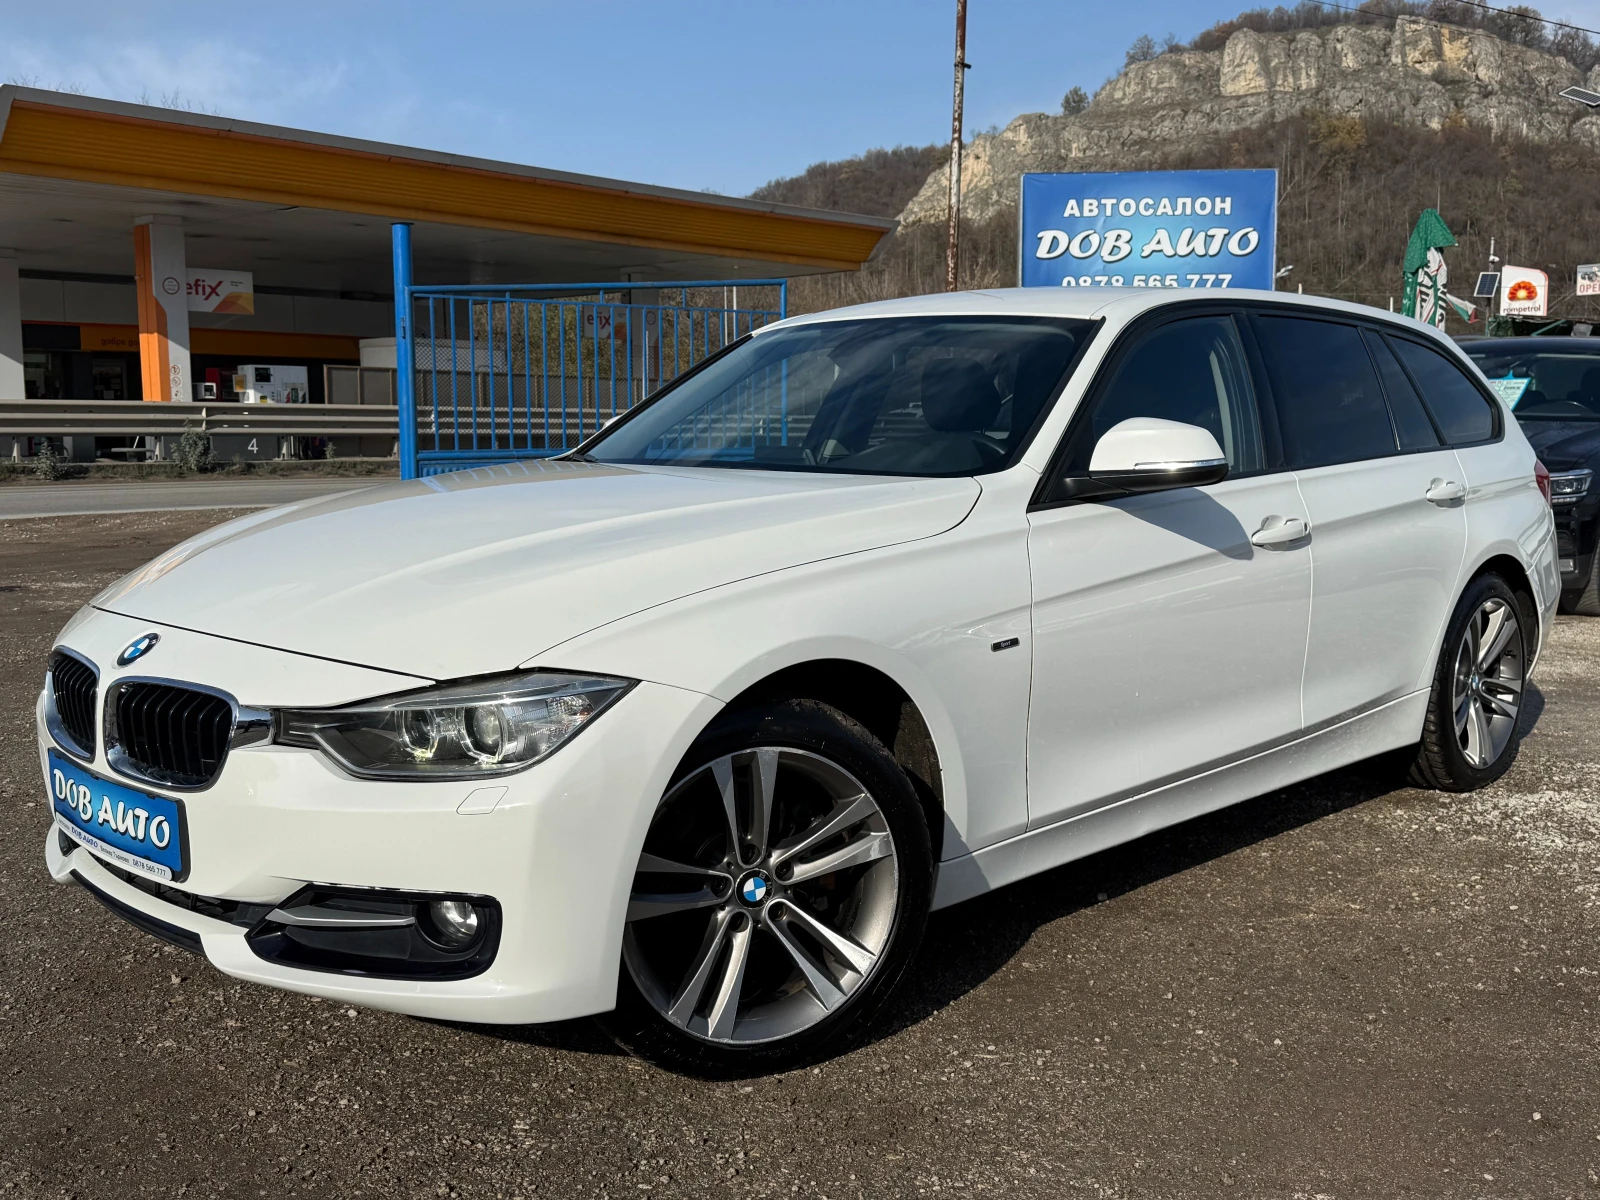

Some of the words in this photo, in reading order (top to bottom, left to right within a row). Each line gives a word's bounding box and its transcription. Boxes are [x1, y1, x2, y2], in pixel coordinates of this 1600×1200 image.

[1063, 196, 1232, 218] АВТОСАЛОН
[1035, 228, 1133, 263] DOB
[1141, 226, 1260, 258] AUTO
[186, 278, 224, 301] efix
[1503, 304, 1541, 314] rompetrol
[587, 311, 611, 330] eix
[128, 339, 140, 348] до
[247, 437, 259, 454] 4
[53, 768, 93, 821] DOB
[98, 795, 170, 848] AUTO
[132, 858, 145, 870] 0878
[145, 863, 155, 873] 565
[157, 867, 166, 877] 777
